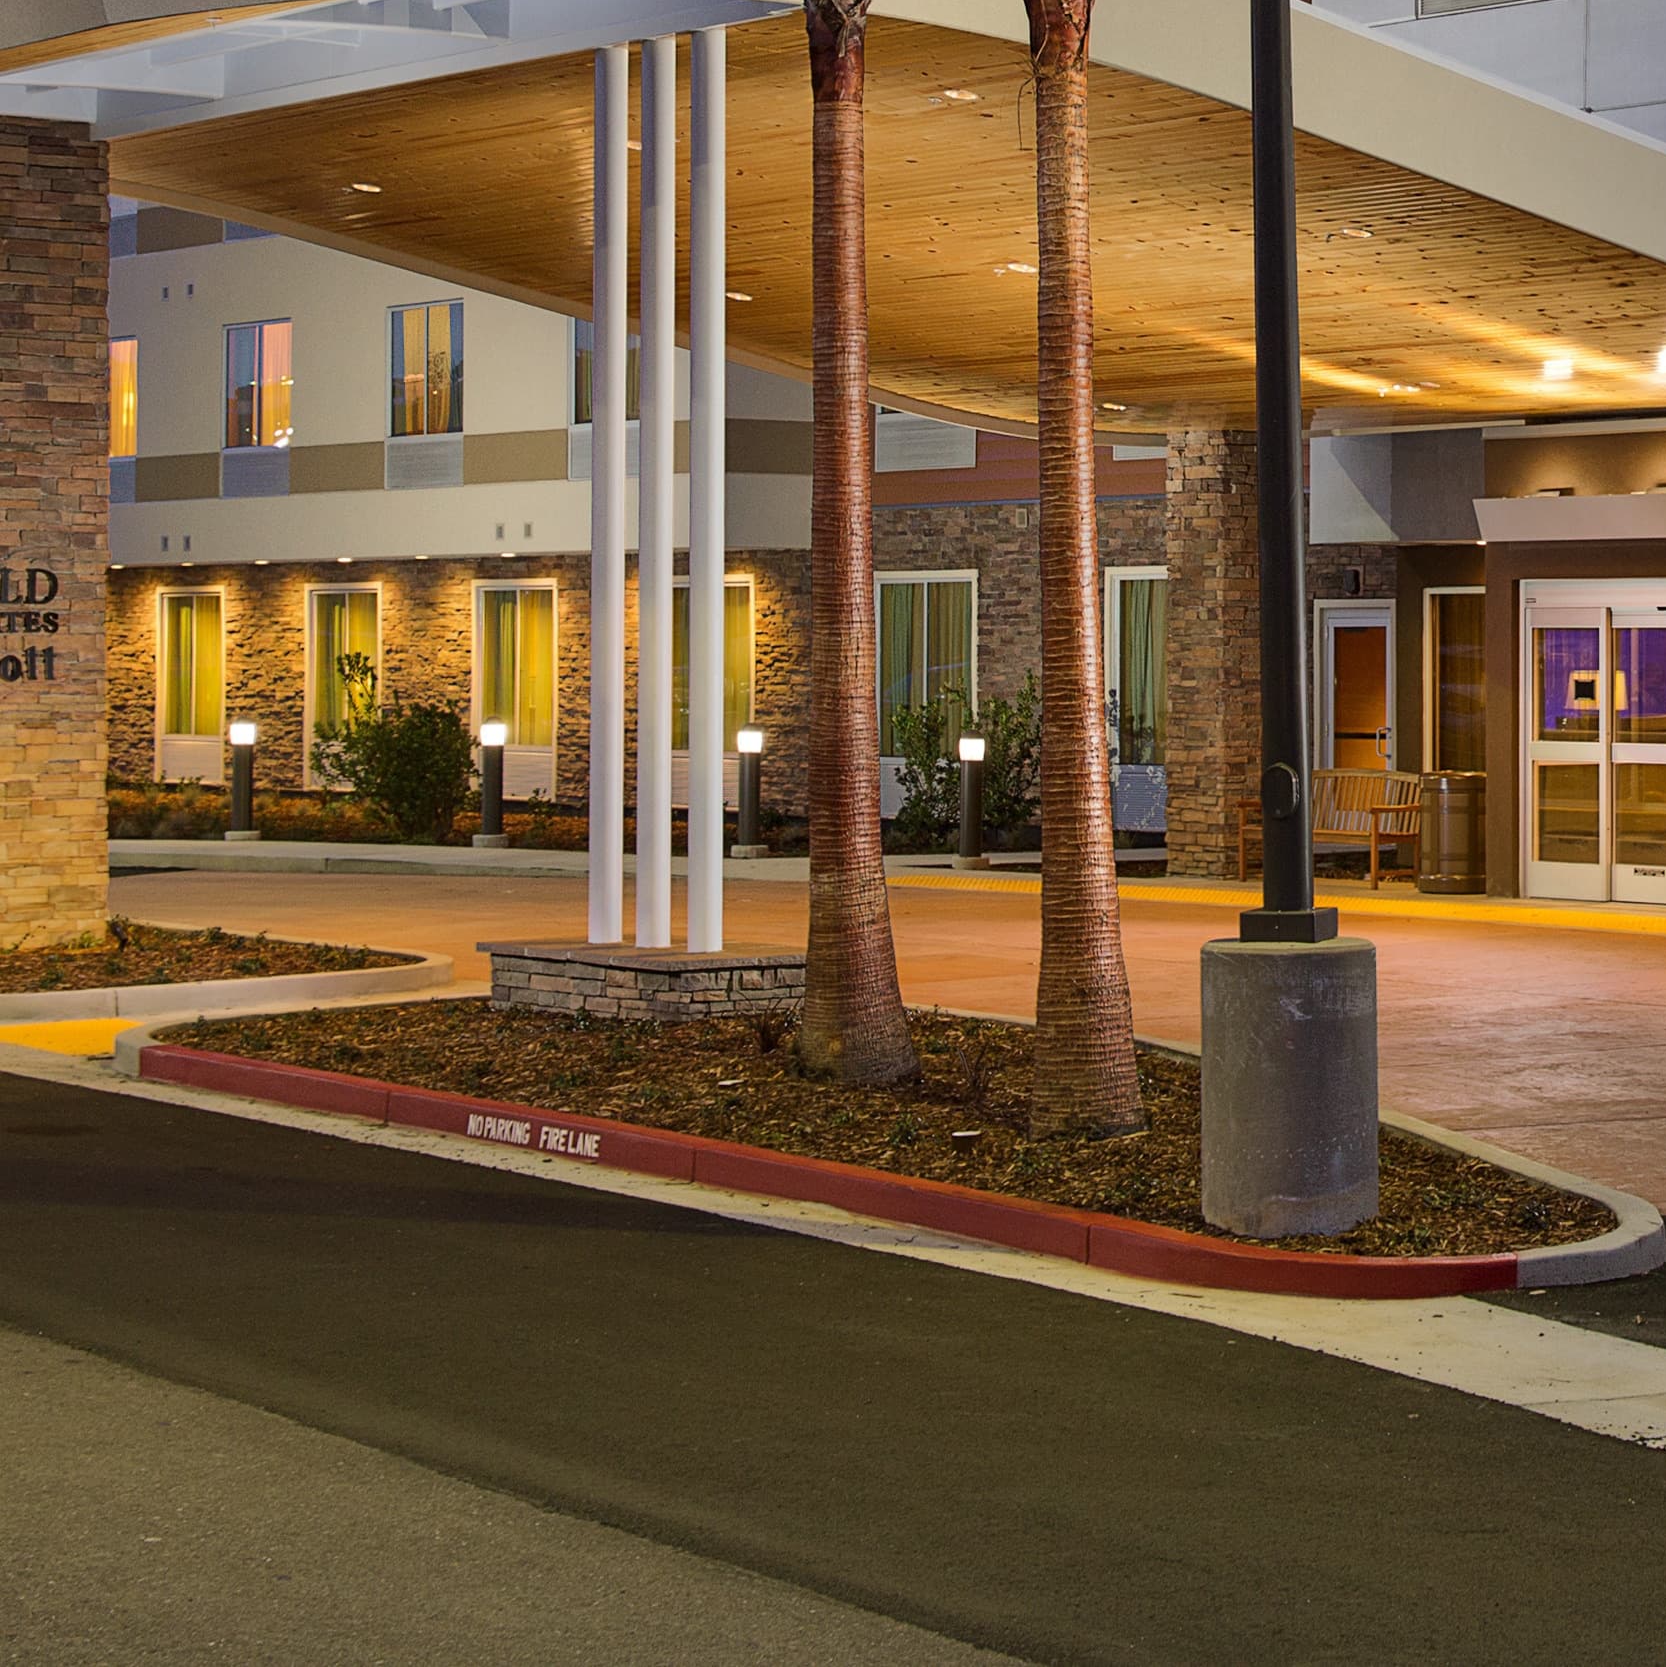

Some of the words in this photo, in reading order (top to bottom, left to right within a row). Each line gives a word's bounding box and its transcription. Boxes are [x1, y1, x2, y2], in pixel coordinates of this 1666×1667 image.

[0, 611, 59, 633] TES
[467, 1113, 484, 1137] NO
[484, 1115, 531, 1145] PARKING
[538, 1126, 568, 1151] FIRE
[568, 1130, 601, 1158] LANE
